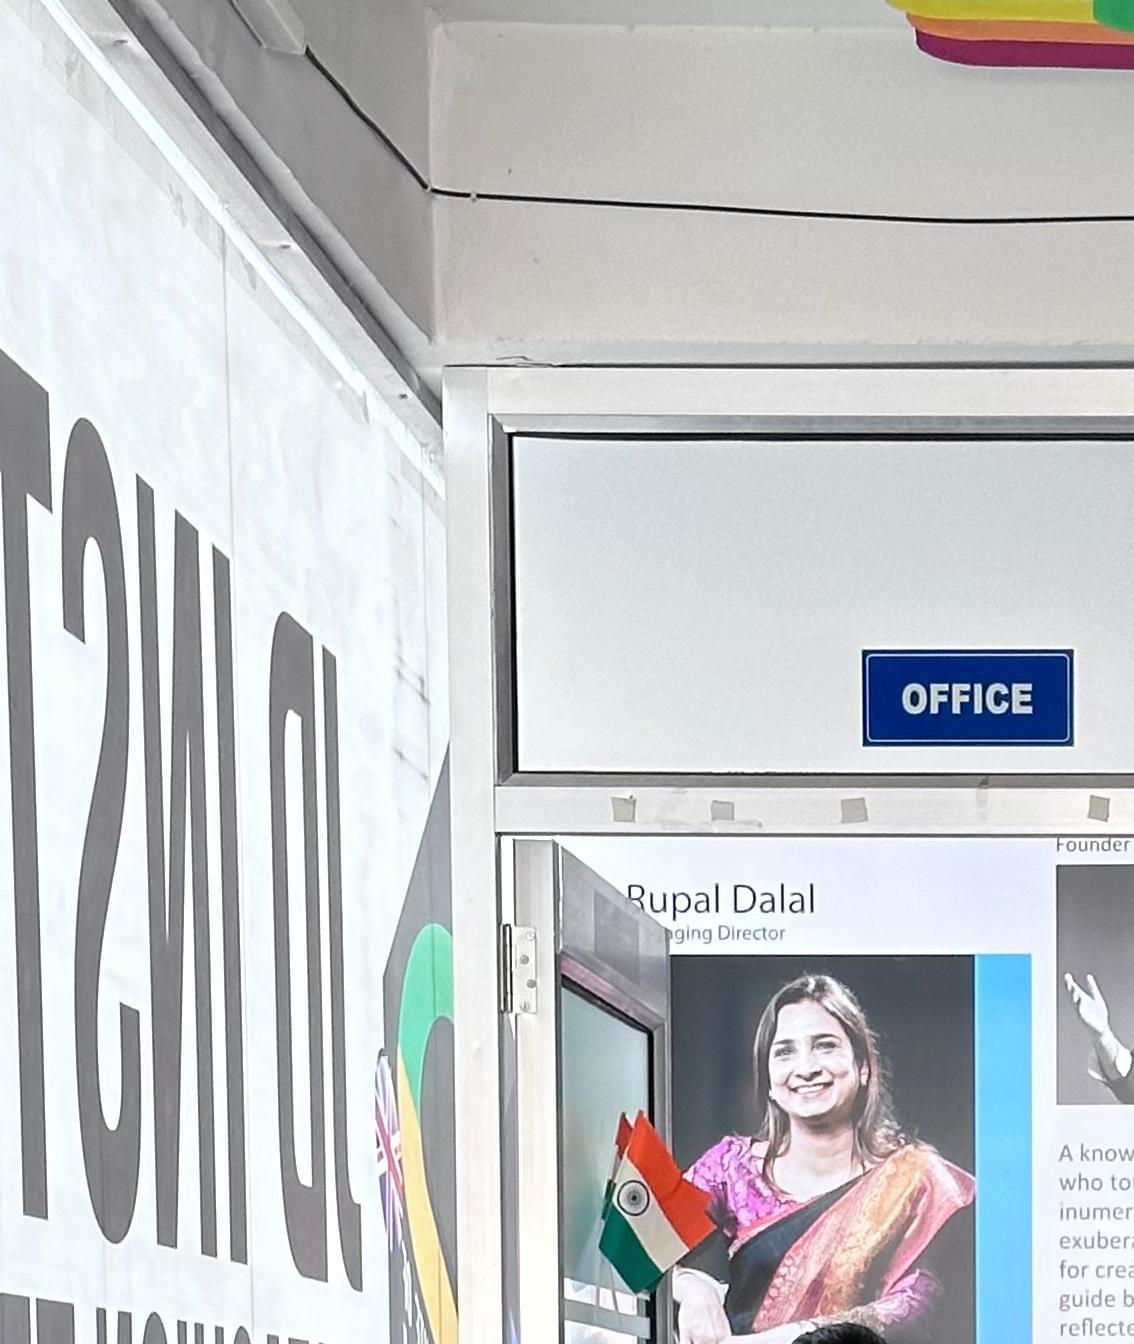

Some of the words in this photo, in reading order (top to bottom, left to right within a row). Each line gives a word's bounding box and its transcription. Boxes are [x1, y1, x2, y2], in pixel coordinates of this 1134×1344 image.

[902, 682, 1033, 715] OFFICE
[1056, 837, 1131, 852] Founder
[627, 882, 719, 921] Rupal
[733, 882, 815, 914] Dalal
[718, 925, 786, 941] Director
[1058, 1144, 1074, 1162] A
[1059, 1172, 1103, 1191] who
[1059, 1259, 1089, 1279] for
[1059, 1288, 1116, 1311] guide
